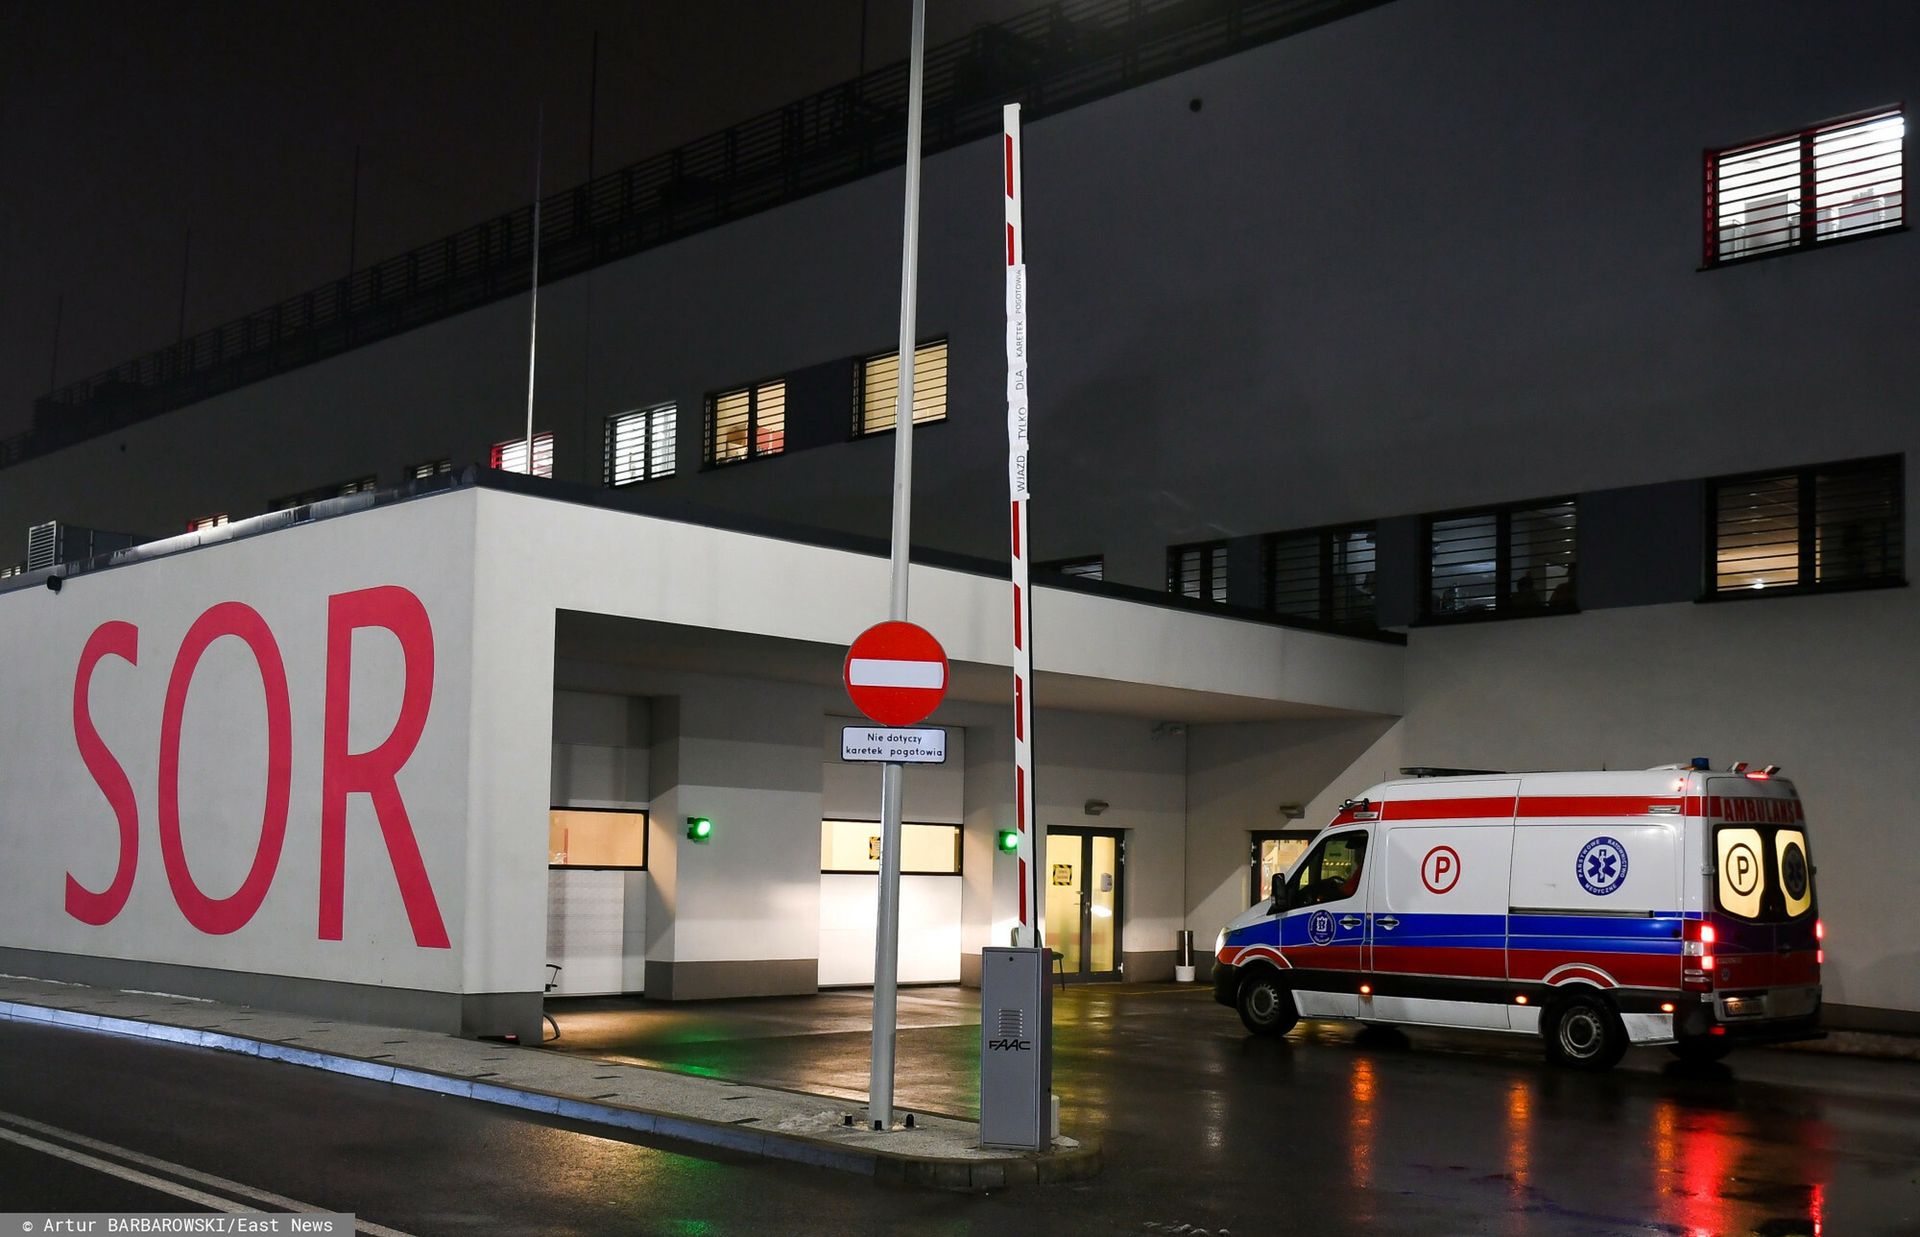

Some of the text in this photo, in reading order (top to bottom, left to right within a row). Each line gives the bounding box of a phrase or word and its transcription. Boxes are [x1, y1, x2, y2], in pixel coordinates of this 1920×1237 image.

[1015, 320, 1024, 358] KARETEK
[1015, 369, 1025, 391] DLA
[1018, 406, 1027, 440] TYLKO
[1016, 455, 1026, 492] WJAZD
[845, 746, 943, 758] karetek pogotowia
[867, 733, 923, 745] Nie dotyczy
[65, 585, 451, 949] SOR
[1434, 856, 1451, 884] P
[1736, 855, 1750, 886] P
[988, 1038, 1031, 1051] FAAC
